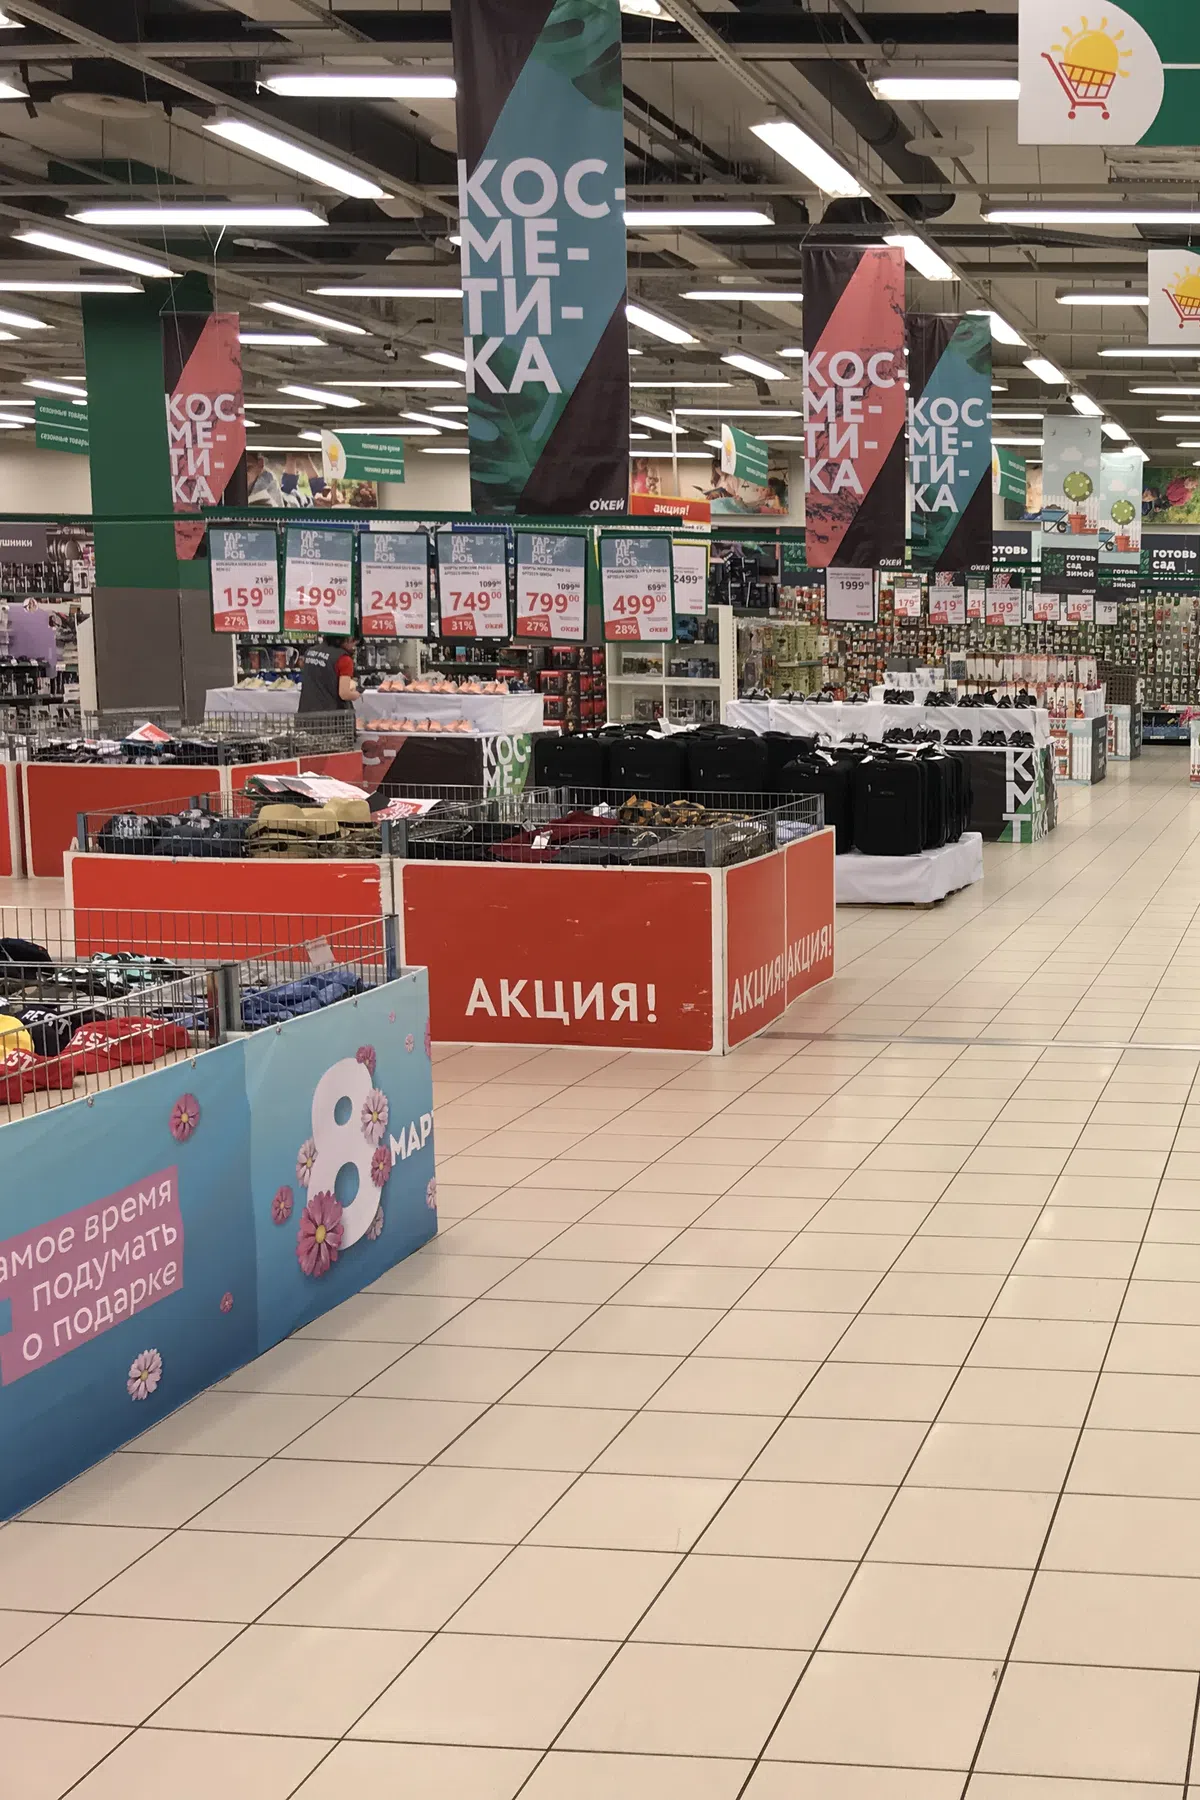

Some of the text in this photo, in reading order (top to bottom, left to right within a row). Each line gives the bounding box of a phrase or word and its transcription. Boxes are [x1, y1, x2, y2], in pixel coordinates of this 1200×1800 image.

[457, 157, 626, 219] КОС-
[459, 218, 590, 277] МЕ-
[461, 278, 584, 336] ТИ-
[464, 336, 563, 394] КА
[803, 351, 906, 388] КОС-
[164, 393, 245, 421] КОС-
[803, 387, 882, 423] МЕ-
[907, 397, 992, 427] КОС-
[167, 421, 227, 449] МЕ-
[803, 423, 878, 459] ТИ-
[908, 427, 973, 455] МЕ-
[169, 448, 225, 476] ТИ-
[909, 455, 970, 484] ТИ-
[804, 458, 864, 494] КА
[171, 475, 216, 503] КА
[910, 483, 959, 513] КА
[653, 504, 690, 516] акция!
[224, 550, 245, 559] РОБ
[300, 549, 321, 558] РОБ
[374, 553, 395, 562] РОБ
[452, 553, 474, 562] РОБ
[532, 555, 553, 565] РОБ
[615, 557, 637, 567] РОБ
[1066, 554, 1096, 562] готовь
[1152, 549, 1197, 559] готовь
[1066, 563, 1082, 571] сад
[1066, 570, 1095, 578] зимой
[1152, 560, 1176, 571] сад
[840, 580, 864, 590] 1999
[223, 587, 263, 607] 159
[296, 585, 336, 607] 199
[371, 590, 412, 611] 249
[449, 591, 491, 611] 749
[526, 592, 568, 614] 799
[612, 595, 656, 615] 499
[899, 599, 915, 607] 179
[934, 600, 957, 611] 419
[991, 602, 1014, 612] 199
[1071, 603, 1088, 611] 169
[224, 615, 246, 626] 27%
[293, 614, 316, 625] 33%
[371, 620, 394, 631] 21%
[451, 621, 474, 631] 31%
[526, 621, 549, 632] 27%
[614, 625, 638, 635] 28%
[786, 923, 832, 983] АКЦИЯ!
[730, 951, 785, 1020] АКЦИЯ!
[465, 977, 658, 1026] АКЦИЯ!
[307, 1057, 434, 1252] 8 МАР
[0, 1180, 172, 1283] амое время
[32, 1223, 178, 1312] подумать
[22, 1260, 177, 1361] о подарке
